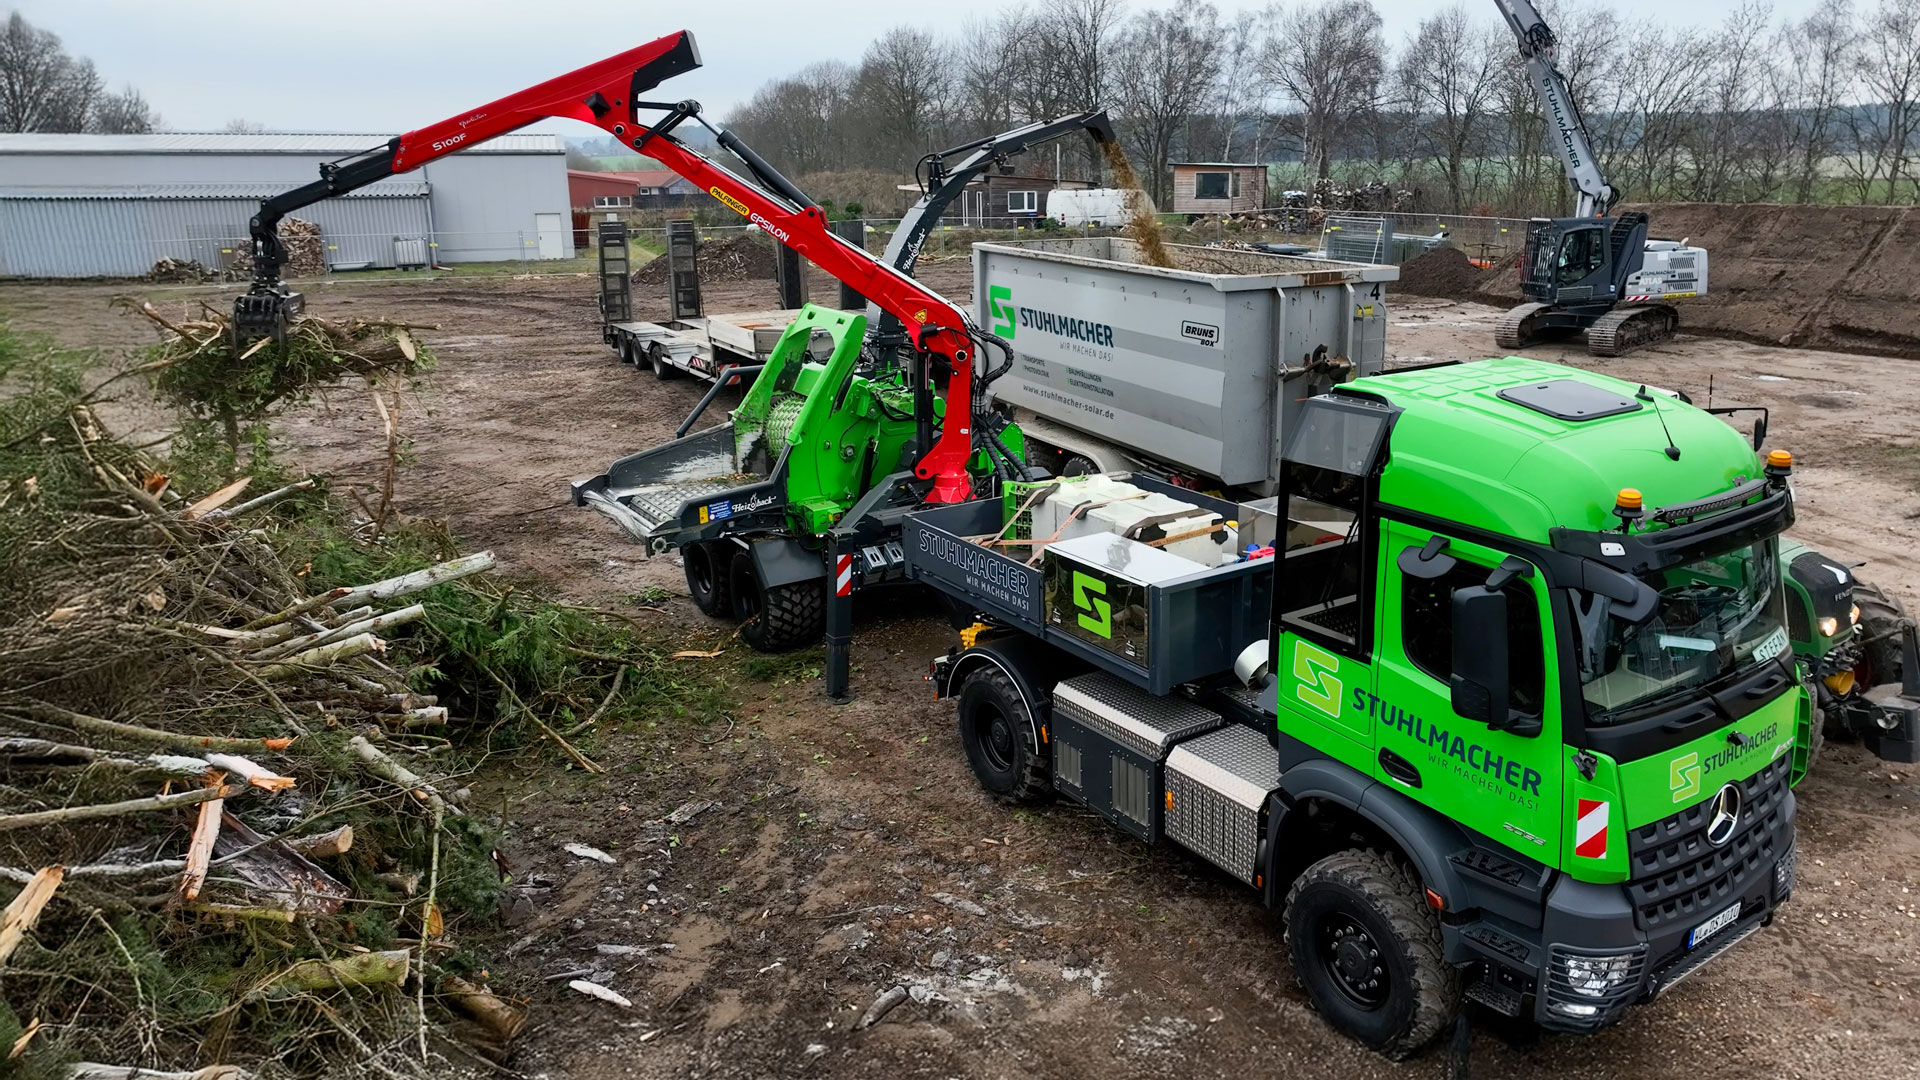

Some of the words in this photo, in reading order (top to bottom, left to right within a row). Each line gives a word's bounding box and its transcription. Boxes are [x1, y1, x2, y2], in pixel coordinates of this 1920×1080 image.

[1542, 77, 1580, 169] STUHLMACHER
[432, 132, 467, 151] S100F
[711, 186, 748, 215] PALFINGER
[750, 212, 790, 242] EPSILON
[1370, 282, 1381, 300] 4
[1020, 307, 1114, 349] STUHLMACHER
[1185, 325, 1215, 339] BRUNS
[1200, 338, 1214, 347] BOX
[1060, 342, 1070, 350] WIR
[1072, 344, 1097, 358] MACHEN
[1098, 350, 1114, 362] DAS!
[1023, 384, 1115, 420] www.stuhlmacher-solar.de
[919, 528, 1030, 598] STUHLMACHER
[965, 574, 979, 588] WIR
[981, 582, 1010, 602] MACHEN
[1759, 632, 1785, 662] STEFAN
[1352, 687, 1542, 797] STUHLMACHER
[1703, 722, 1778, 775] STUHLMACHER
[1428, 752, 1448, 769] WIR
[1454, 765, 1503, 796] MACHEN
[1509, 790, 1539, 812] DAS!
